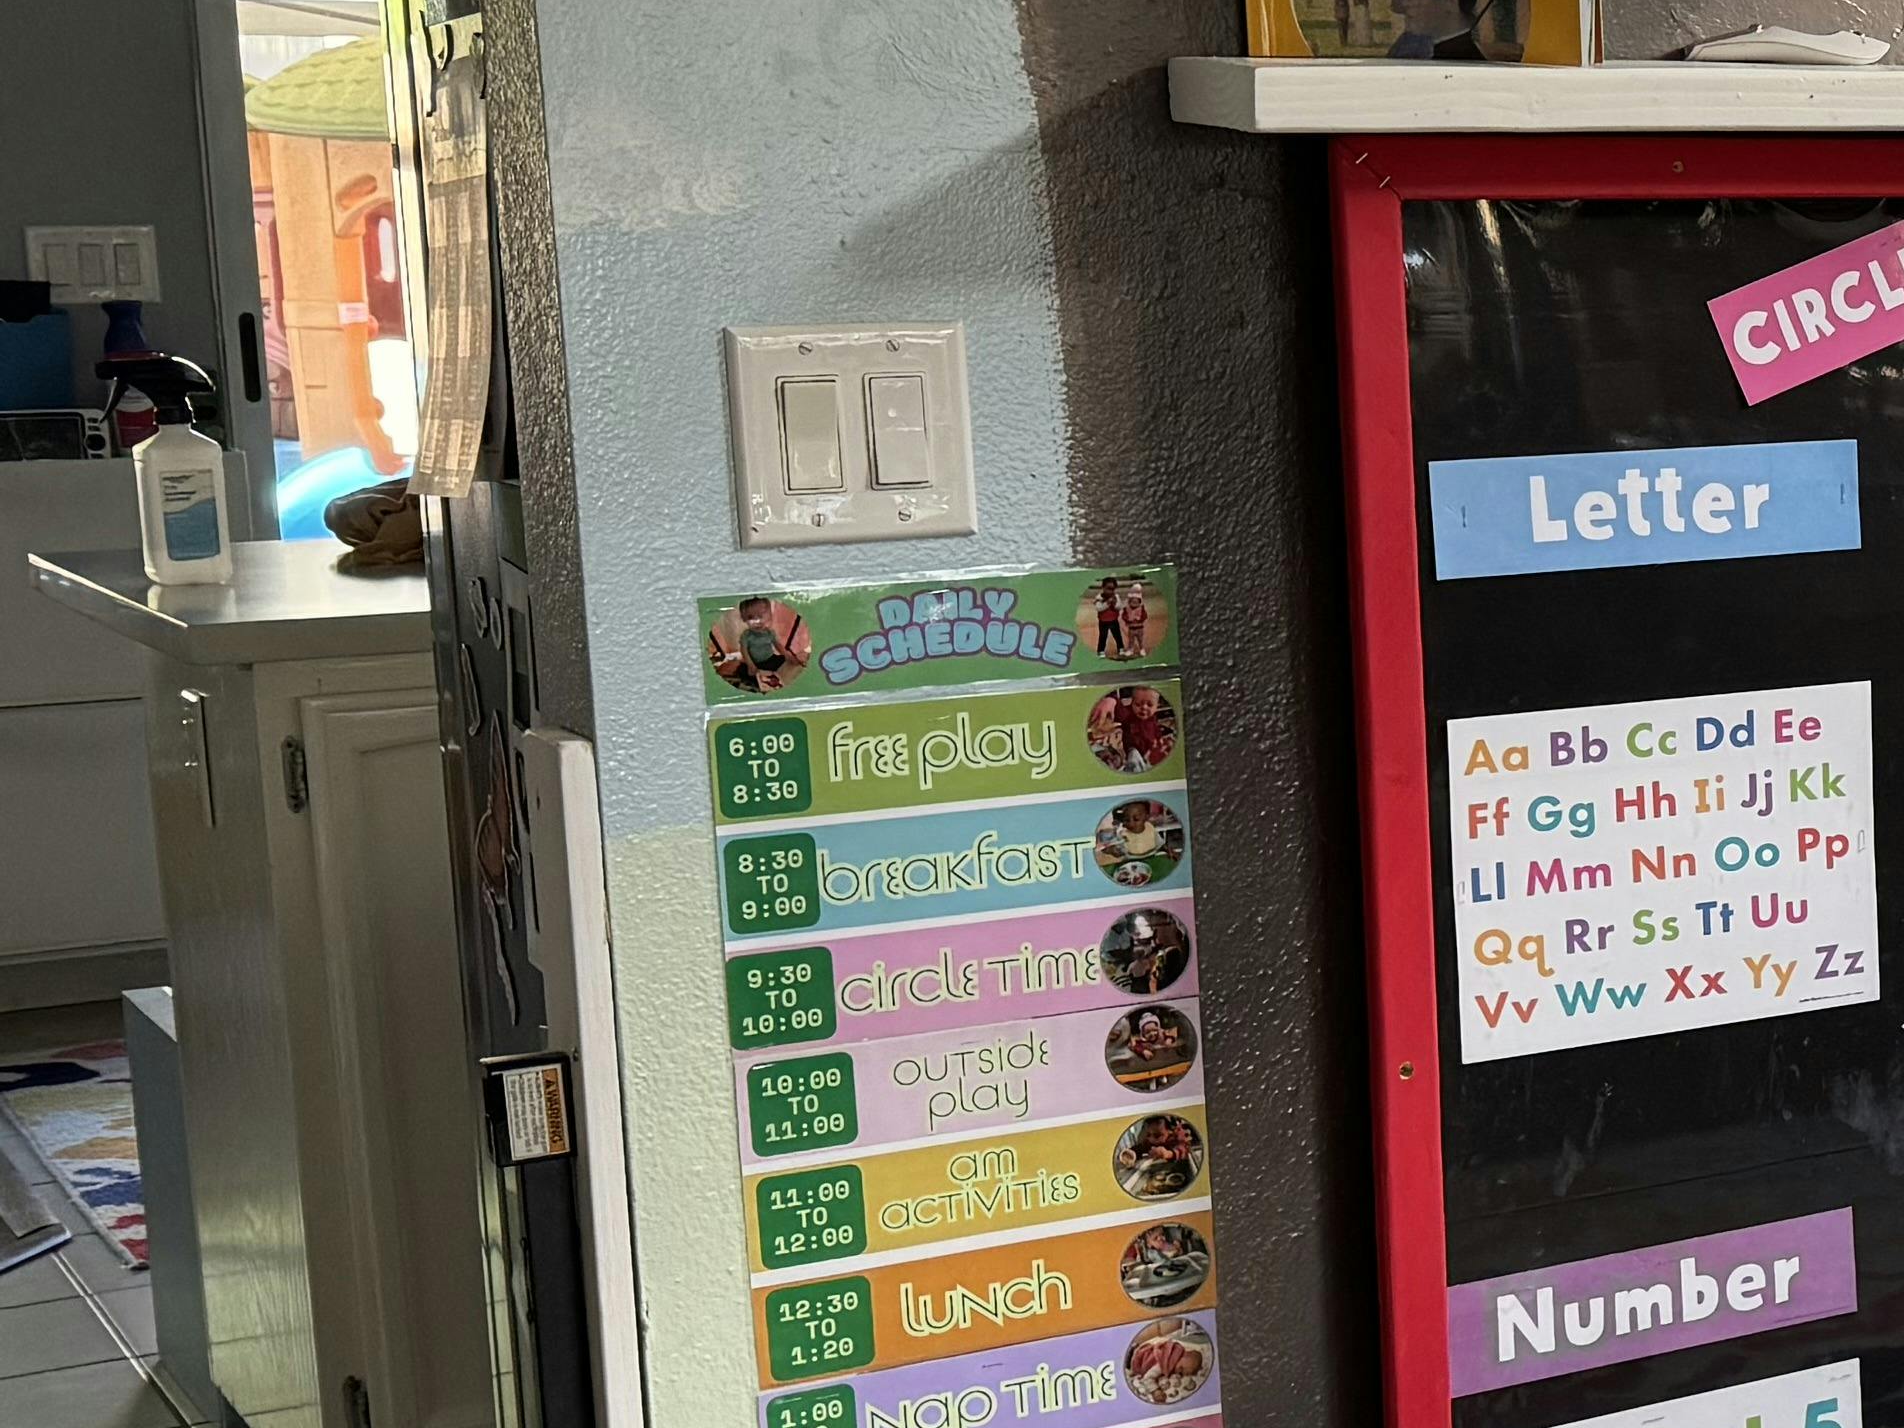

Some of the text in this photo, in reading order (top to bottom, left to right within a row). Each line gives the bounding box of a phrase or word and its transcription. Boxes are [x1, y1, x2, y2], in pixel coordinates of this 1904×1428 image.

[1529, 467, 1771, 545] Letter
[877, 588, 1015, 630] DAILY
[820, 622, 1076, 686] SCHEDULE
[728, 732, 795, 758] 6:00
[748, 759, 780, 779] TO
[920, 712, 1057, 790] play
[1464, 709, 1822, 776] Aa Bb Cc Dd Ee
[732, 780, 799, 805] 8:30
[927, 1076, 1029, 1131] play
[1497, 1255, 1800, 1362] Number
